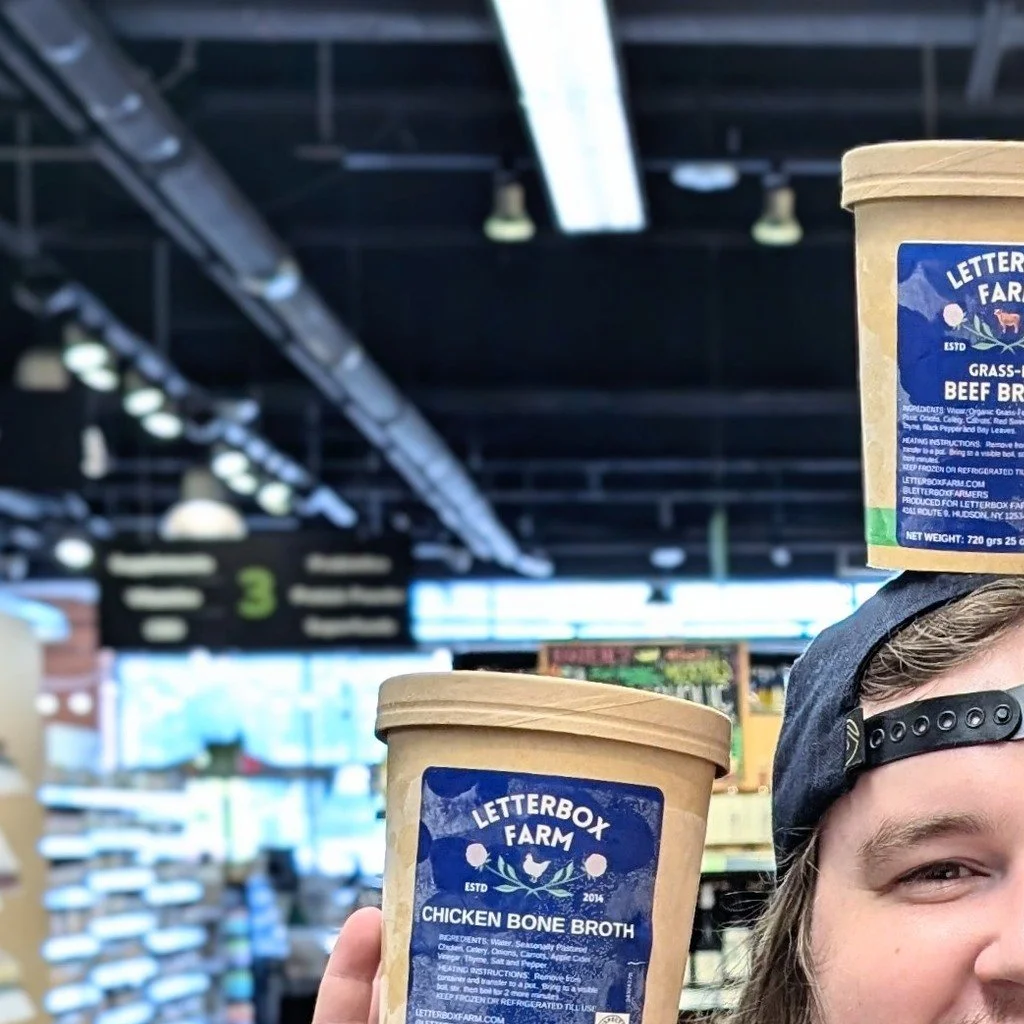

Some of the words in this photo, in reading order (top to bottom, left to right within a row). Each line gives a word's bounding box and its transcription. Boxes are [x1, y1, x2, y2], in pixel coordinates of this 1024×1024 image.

[944, 342, 966, 351] ESTD
[944, 381, 991, 401] BEEF
[902, 476, 986, 488] LETTERBOXFARM.COM
[902, 496, 940, 506] PRODUCED
[942, 500, 958, 508] FOR
[960, 500, 1008, 509] LETTERBOX
[918, 508, 942, 517] ROUTE
[906, 531, 922, 541] NET
[924, 532, 964, 544] WEIGHT:
[967, 535, 984, 544] 720
[986, 537, 1002, 546] grs
[1005, 537, 1016, 545] 25
[236, 566, 275, 620] 3
[472, 794, 610, 841] LETTERBOX
[504, 824, 574, 852] FARM
[464, 882, 488, 893] ESTD
[583, 892, 604, 903] 2014
[422, 906, 501, 928] CHICKEN
[506, 912, 566, 933] BONE
[571, 918, 634, 938] BROTH
[500, 998, 563, 1010] REFRIGERATED
[564, 1004, 580, 1012] TILL
[416, 1009, 505, 1024] LETTERBOXFARM.COM
